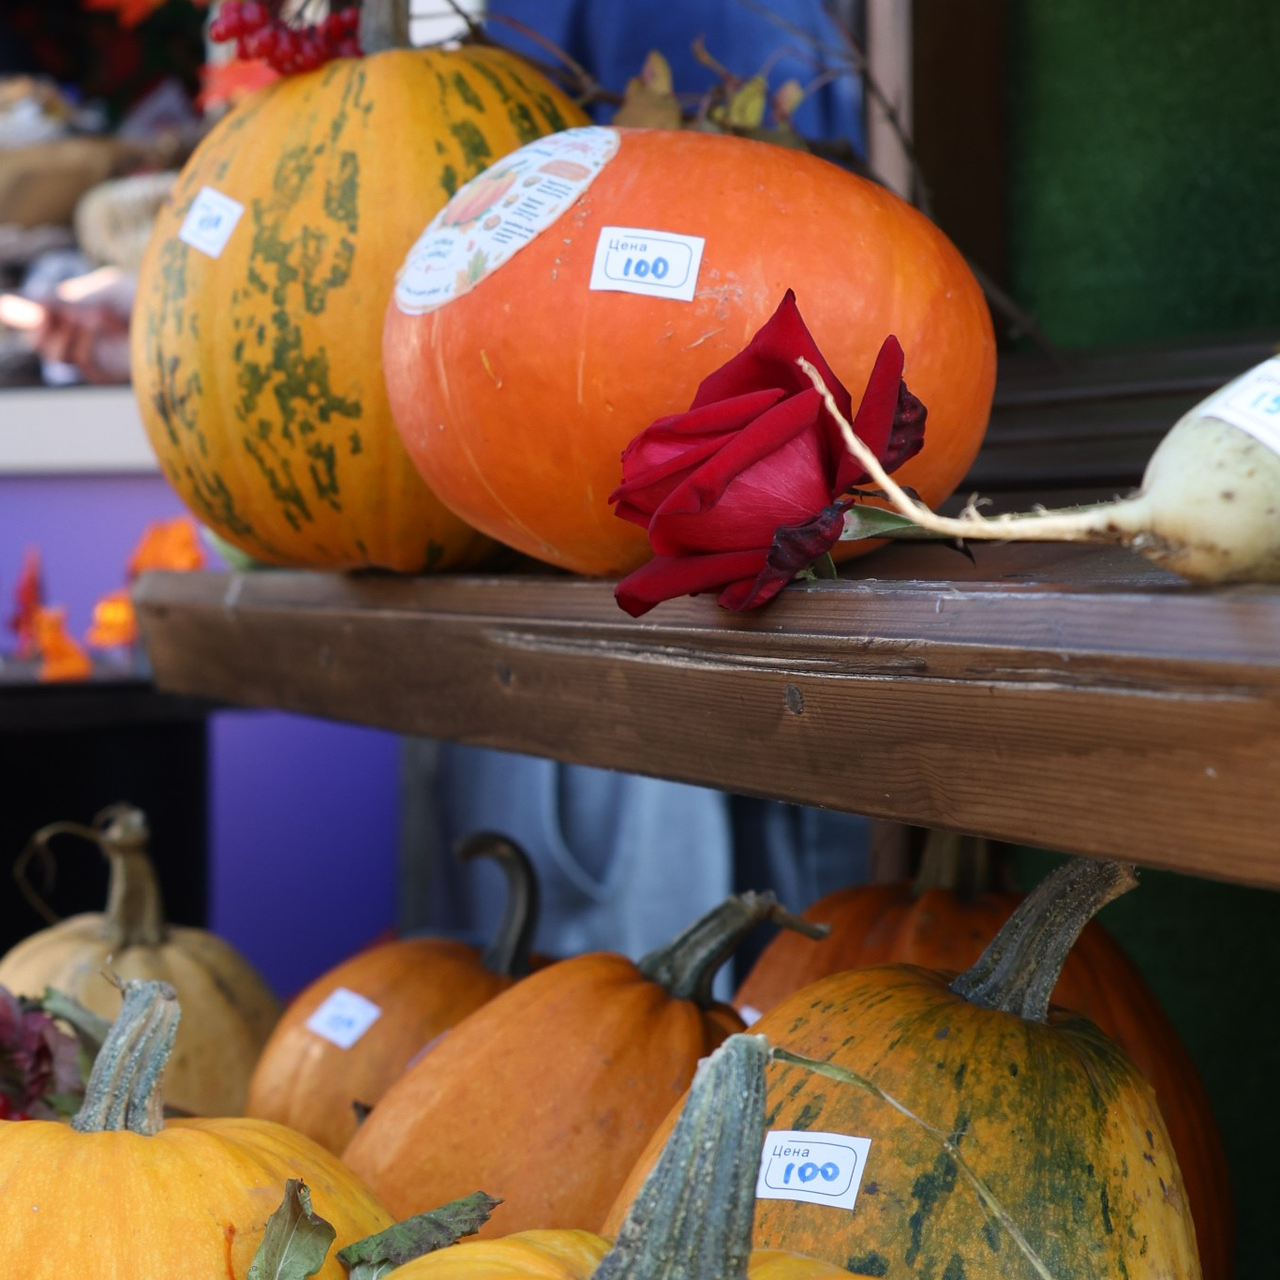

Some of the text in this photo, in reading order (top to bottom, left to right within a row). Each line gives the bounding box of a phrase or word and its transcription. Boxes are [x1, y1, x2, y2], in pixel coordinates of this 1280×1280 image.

[609, 239, 648, 252] Цена
[623, 257, 669, 280] 100
[772, 1145, 810, 1159] Цена
[783, 1162, 840, 1184] 100
